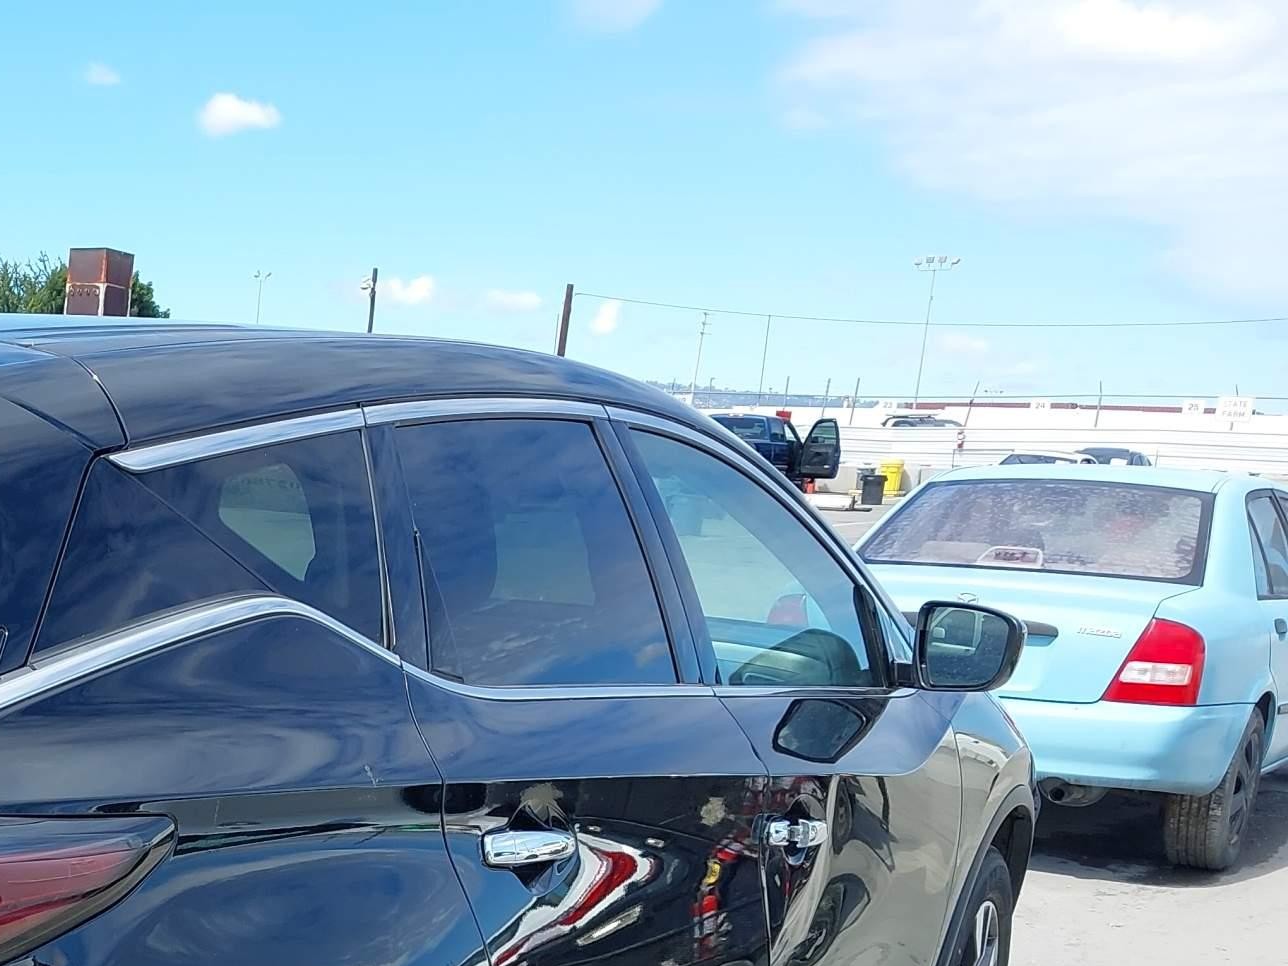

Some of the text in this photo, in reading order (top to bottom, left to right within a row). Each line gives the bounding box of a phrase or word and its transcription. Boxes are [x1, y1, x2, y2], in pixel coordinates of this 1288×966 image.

[1035, 401, 1045, 409] 24
[1187, 402, 1200, 411] 25
[1223, 399, 1249, 408] STATE
[1222, 410, 1246, 418] FARM
